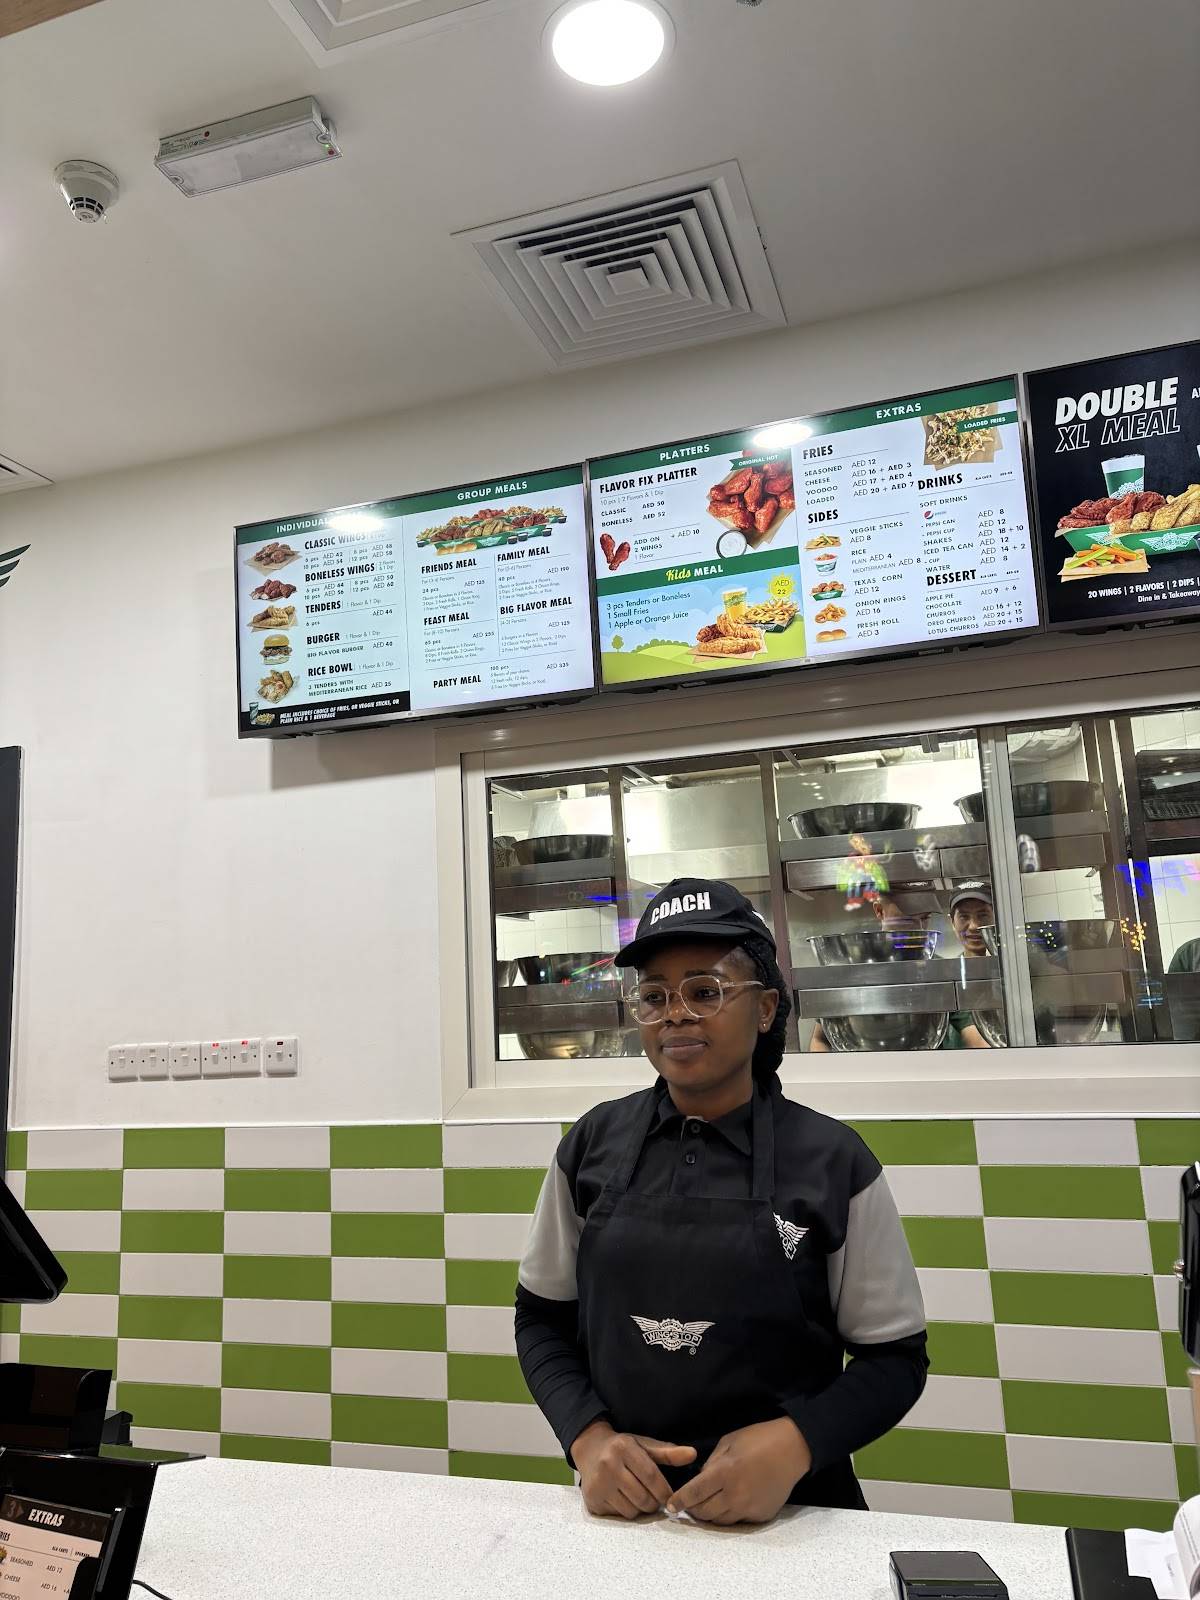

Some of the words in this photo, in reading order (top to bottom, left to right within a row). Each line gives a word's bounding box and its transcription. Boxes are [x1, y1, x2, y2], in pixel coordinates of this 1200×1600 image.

[1055, 377, 1179, 425] DOUBLE
[876, 402, 922, 419] EXTRAS
[964, 420, 989, 429] LOADED
[990, 416, 1006, 424] FRIES
[1055, 423, 1090, 453] XL
[1100, 407, 1180, 446] MEAL
[660, 444, 710, 461] PLATTERS
[803, 444, 833, 460] FRIES
[738, 457, 764, 466] ORIGINAL
[766, 454, 778, 462] HOT
[804, 465, 843, 477] SEASONED
[851, 460, 866, 469] AED
[600, 479, 635, 494] FLAVOR
[638, 475, 654, 487] FIX
[657, 467, 697, 483] PLATTER
[805, 477, 831, 486] CHEESE
[851, 469, 867, 478] AED
[917, 473, 963, 491] DRINKS
[457, 488, 492, 501] GROUP
[495, 481, 528, 494] MEALS
[806, 485, 838, 496] VOODOO
[852, 480, 867, 488] AED
[806, 495, 835, 506] LOADED
[853, 489, 868, 497] AED
[919, 500, 937, 509] SOFT
[939, 495, 968, 505] DRINKS
[600, 507, 626, 517] CLASSIC
[642, 502, 655, 510] AED
[808, 509, 839, 524] SIDES
[601, 517, 633, 528] BONELESS
[849, 526, 877, 535] VEGGIE
[879, 520, 903, 530] STICKS
[304, 537, 336, 550] CLASSIC
[338, 534, 366, 544] WINGS
[634, 537, 648, 546] ADD
[677, 530, 691, 538] AED
[850, 536, 865, 544] AED
[923, 537, 953, 546] SHAKES
[497, 550, 525, 562] FAMILY
[528, 546, 550, 558] MEAL
[640, 543, 663, 552] WINGS
[923, 547, 940, 555] ICED
[957, 542, 974, 550] CAN
[870, 554, 885, 562] AED
[898, 559, 914, 567] AED
[305, 568, 345, 582] BONELESS
[347, 562, 375, 576] WINGS
[421, 561, 453, 575] FRIENDS
[456, 558, 477, 570] MEAL
[665, 568, 692, 582] Kids
[694, 564, 724, 578] MEAL
[925, 564, 951, 573] WATER
[775, 579, 790, 587] AED
[854, 578, 877, 587] TEXAS
[881, 573, 903, 582] CORN
[926, 569, 977, 586] DESSERT
[854, 587, 869, 595] AED
[1088, 591, 1098, 599] 20
[1098, 587, 1122, 598] WINGS
[1135, 581, 1165, 593] FLAVORS
[1172, 580, 1178, 588] 2
[1178, 578, 1195, 588] DIPS
[500, 605, 514, 615] BIG
[517, 600, 548, 613] FLAVOR
[550, 596, 573, 608] MEAL
[606, 603, 611, 611] 3
[613, 602, 624, 612] pcs
[626, 598, 651, 609] Tenders
[661, 591, 691, 602] Boneless
[855, 600, 881, 608] ONION
[883, 595, 906, 604] RINGS
[925, 594, 943, 602] APPLE
[925, 600, 962, 610] CHOCOLATE
[1138, 595, 1153, 603] Dine
[305, 600, 341, 614] TENDERS
[613, 609, 632, 619] Small
[633, 607, 650, 616] Fries
[855, 609, 871, 617] AED
[926, 610, 956, 619] CHURROS
[424, 615, 446, 626] FEAST
[448, 612, 470, 623] MEAL
[614, 618, 634, 630] Apple
[644, 613, 671, 624] Orange
[672, 610, 690, 621] Juice
[857, 621, 879, 629] FRESH
[881, 618, 900, 626] ROLL
[949, 623, 979, 632] CHURROS
[307, 632, 340, 645] BURGER
[308, 666, 326, 677] RICE
[329, 662, 353, 674] BOWL
[314, 681, 338, 689] TENDERS
[433, 677, 457, 689] PARTY
[460, 674, 482, 685] MEAL
[650, 891, 712, 926] COACH
[28, 1508, 65, 1527] EXTRAS
[10, 1556, 34, 1567] SEASONED
[4, 1574, 21, 1583] CHEESE
